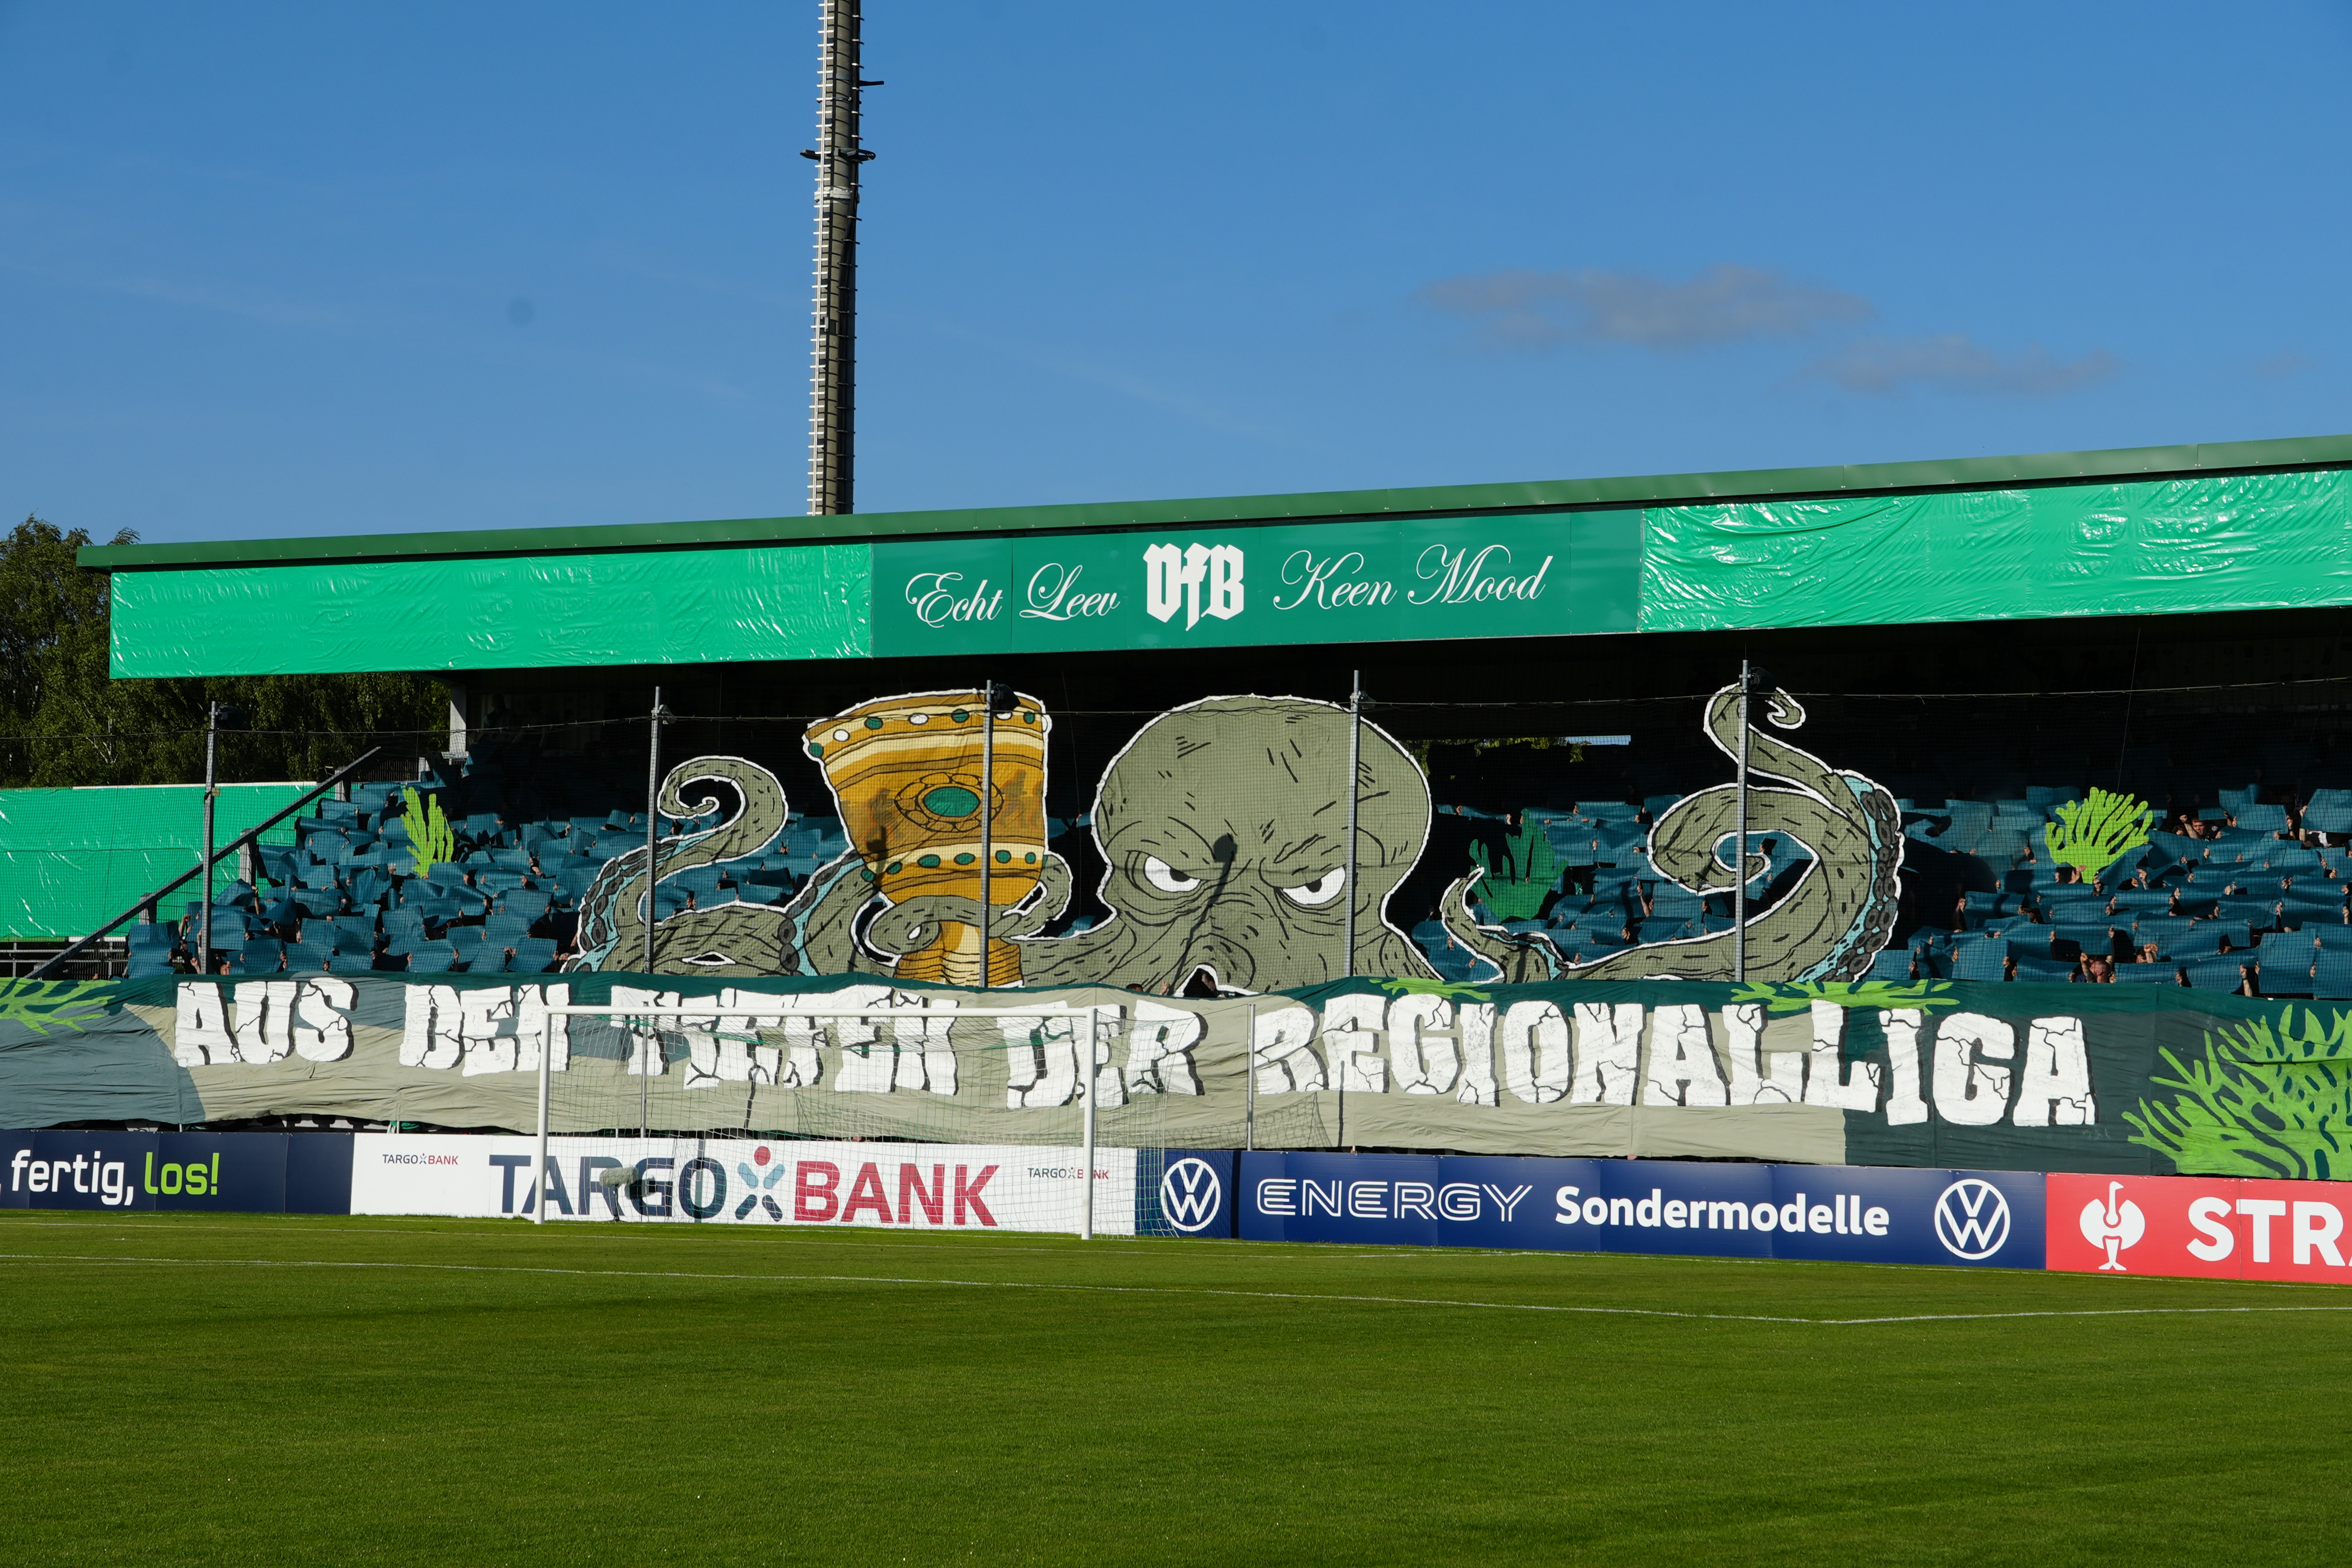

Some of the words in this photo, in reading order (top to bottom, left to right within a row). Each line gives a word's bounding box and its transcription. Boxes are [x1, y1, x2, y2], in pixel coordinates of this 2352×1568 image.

[905, 572, 1003, 628] Echt
[1019, 562, 1121, 621] Leev
[1273, 550, 1398, 610] Keen
[1407, 544, 1554, 605] Mood
[175, 977, 359, 1068] AUS
[399, 983, 572, 1077] DEN
[996, 999, 1209, 1110] DER
[1248, 993, 2100, 1128] REGIONALLIGA
[11, 1149, 134, 1206] fertig,
[144, 1152, 220, 1195] los!
[1257, 1178, 1533, 1222] ENERGY
[1555, 1185, 1890, 1236] Sondermodelle
[2186, 1196, 2352, 1267] STR
